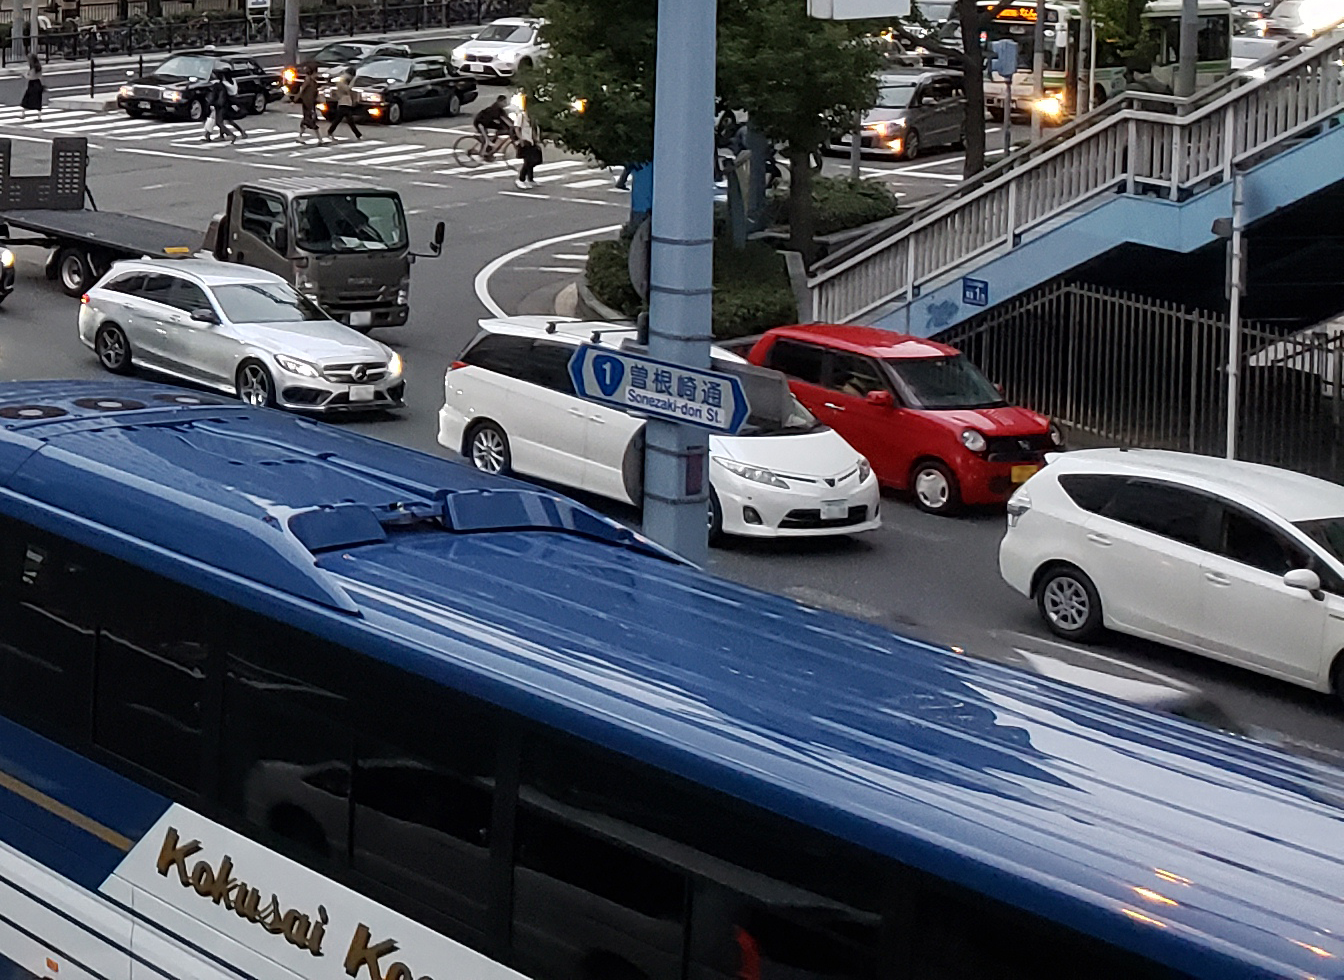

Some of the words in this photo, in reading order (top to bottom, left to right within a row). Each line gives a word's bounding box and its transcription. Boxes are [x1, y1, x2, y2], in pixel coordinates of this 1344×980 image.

[602, 361, 611, 385] 1
[629, 363, 722, 408] 曽根崎通
[627, 387, 703, 420] Sonezaki-dori
[706, 406, 722, 424] St.
[155, 826, 330, 957] Kokusai
[343, 922, 436, 980] Ko
